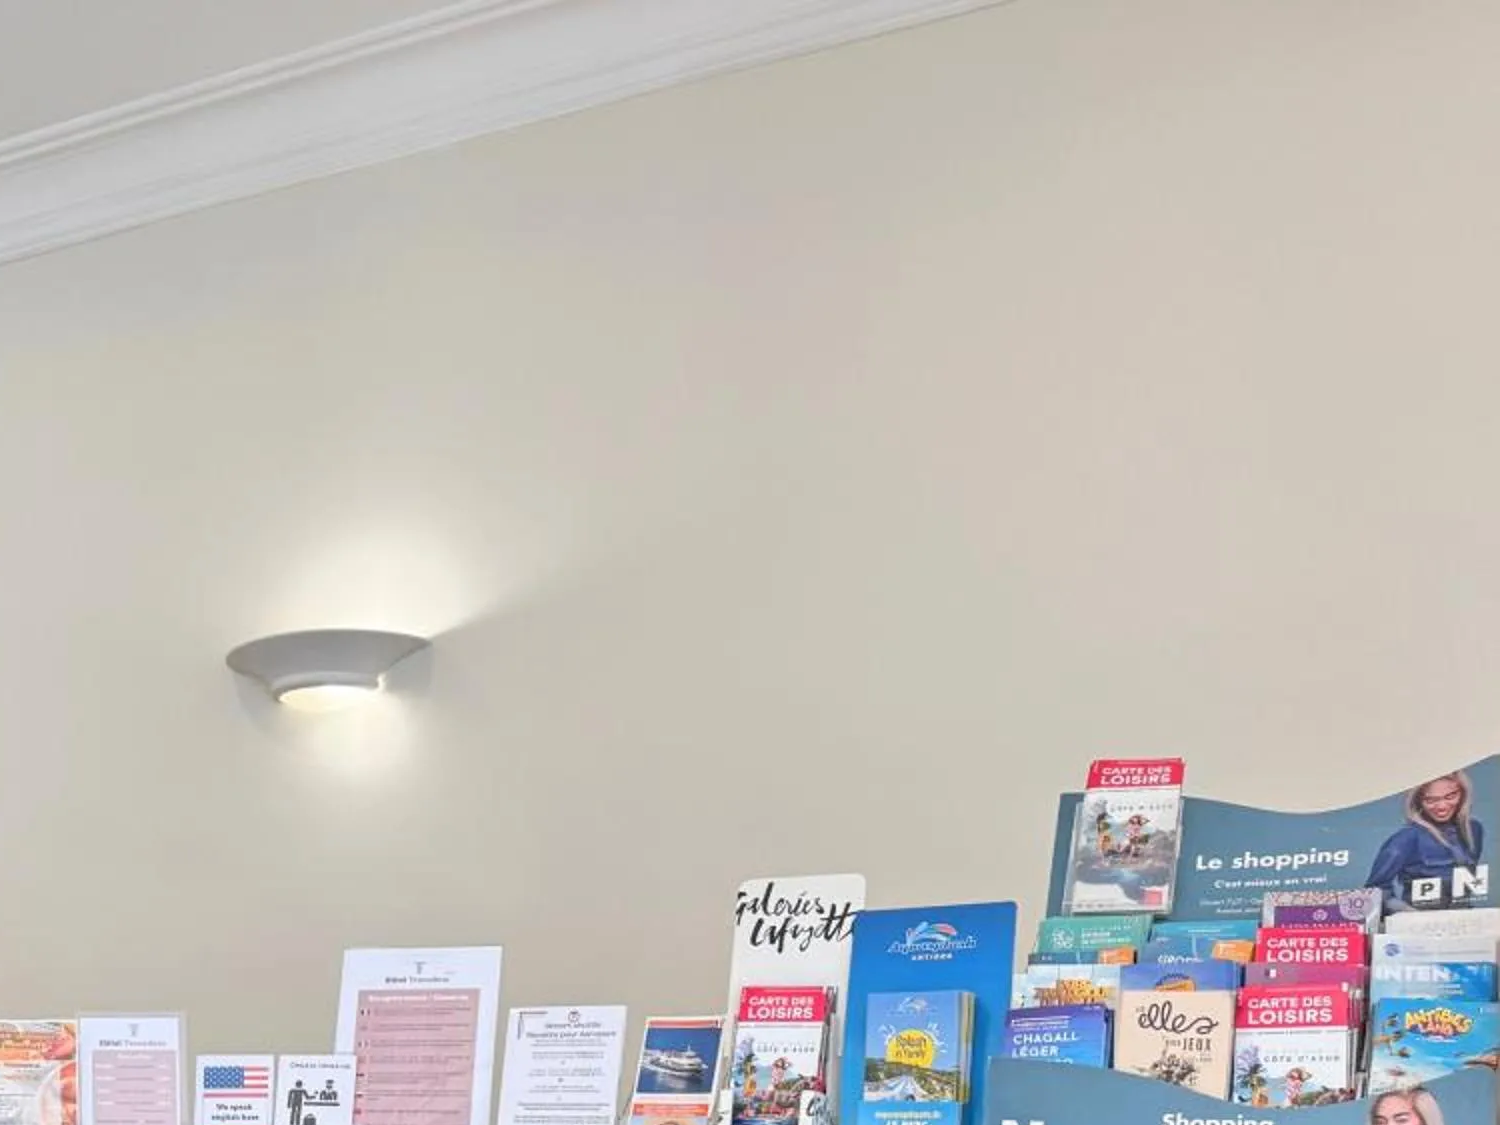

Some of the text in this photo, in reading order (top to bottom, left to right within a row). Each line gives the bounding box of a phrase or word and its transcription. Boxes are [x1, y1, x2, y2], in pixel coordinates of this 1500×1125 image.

[1101, 766, 1173, 775] CARTE DES
[1100, 774, 1172, 785] LOISIRS
[1196, 848, 1350, 871] Le shopping
[1214, 879, 1242, 889] C'est
[1303, 874, 1328, 884] vrai
[1452, 863, 1489, 898] N
[1420, 882, 1435, 897] P
[1266, 937, 1349, 948] CARTE DES
[1266, 949, 1349, 962] LOISIRS
[749, 996, 789, 1006] CARTE
[1247, 996, 1332, 1008] CARTE DES
[747, 1007, 814, 1020] LOISIRS
[1247, 1009, 1333, 1024] LOISIRS
[1013, 1031, 1079, 1045] CHAGALL
